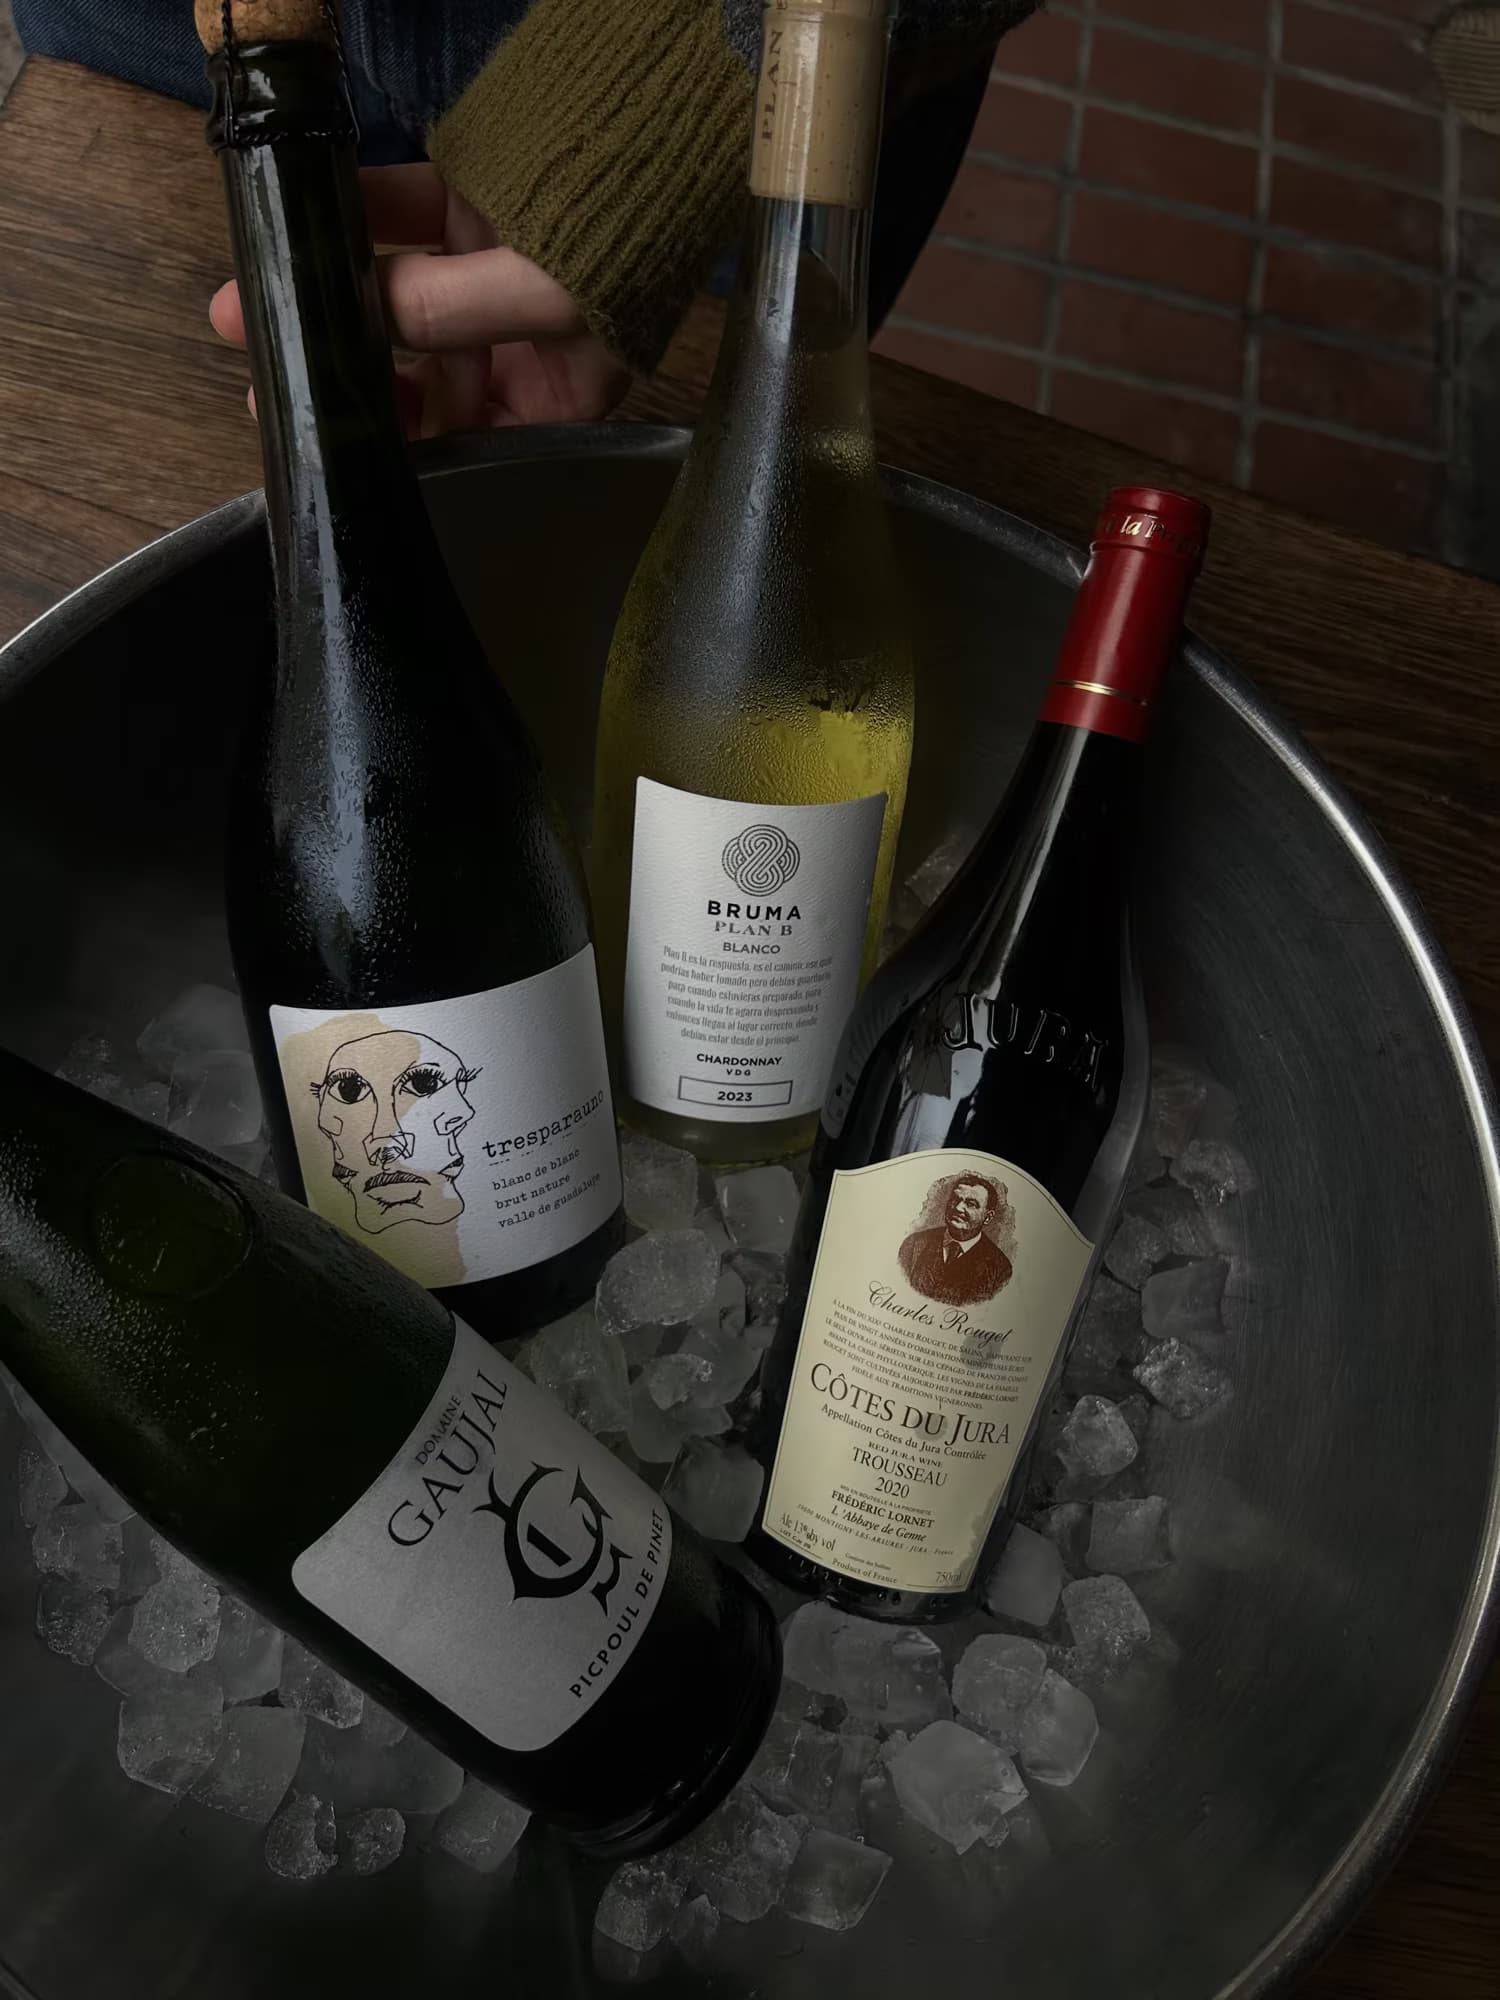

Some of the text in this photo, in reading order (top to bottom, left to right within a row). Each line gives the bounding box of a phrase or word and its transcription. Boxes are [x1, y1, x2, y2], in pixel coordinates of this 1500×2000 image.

[762, 30, 783, 140] PLAN
[707, 900, 801, 921] BRUMA
[714, 921, 793, 937] PLAN B
[723, 942, 781, 955] BLANCO
[696, 1053, 782, 1067] CHARDONNAY
[943, 991, 1110, 1094] JURA
[717, 1091, 753, 1102] 2023
[481, 1090, 605, 1158] tresparauno
[492, 1149, 580, 1191] blanc de blanc
[496, 1173, 571, 1210] brut nature
[498, 1173, 600, 1228] valle de guadalupe
[858, 1322, 878, 1336] VINGT
[868, 1280, 1014, 1349] Charles Rouget
[847, 1329, 878, 1347] OUVRAGE
[922, 1358, 935, 1368] LES
[936, 1362, 966, 1376] CÉPAGES
[882, 1322, 915, 1339] CHARLES
[948, 1343, 959, 1352] DE
[847, 1351, 866, 1365] SONT
[950, 1386, 962, 1396] PAR
[875, 1375, 890, 1386] AUX
[891, 1380, 935, 1400] TRADITIONS
[937, 1371, 949, 1382] LES
[950, 1374, 976, 1388] VIGNES
[810, 1362, 1011, 1446] CÔTES DU JURA
[414, 1394, 462, 1467] DOMAINE
[820, 1402, 987, 1461] Appellation Côtes du Jura Contrôlée
[387, 1368, 508, 1547] GAUJAL
[851, 1446, 948, 1488] TROUSSEAU
[868, 1441, 943, 1469] RED JURA WINE
[874, 1476, 911, 1500] 2020
[831, 1490, 936, 1529] FRÉDÉRIC LORNET
[821, 1538, 837, 1552] vol
[881, 1523, 894, 1535] de
[896, 1527, 928, 1543] Genne
[831, 1558, 861, 1576] Product
[862, 1569, 872, 1578] of
[873, 1571, 897, 1584] France
[568, 1510, 665, 1698] PICPOUL DE PINET
